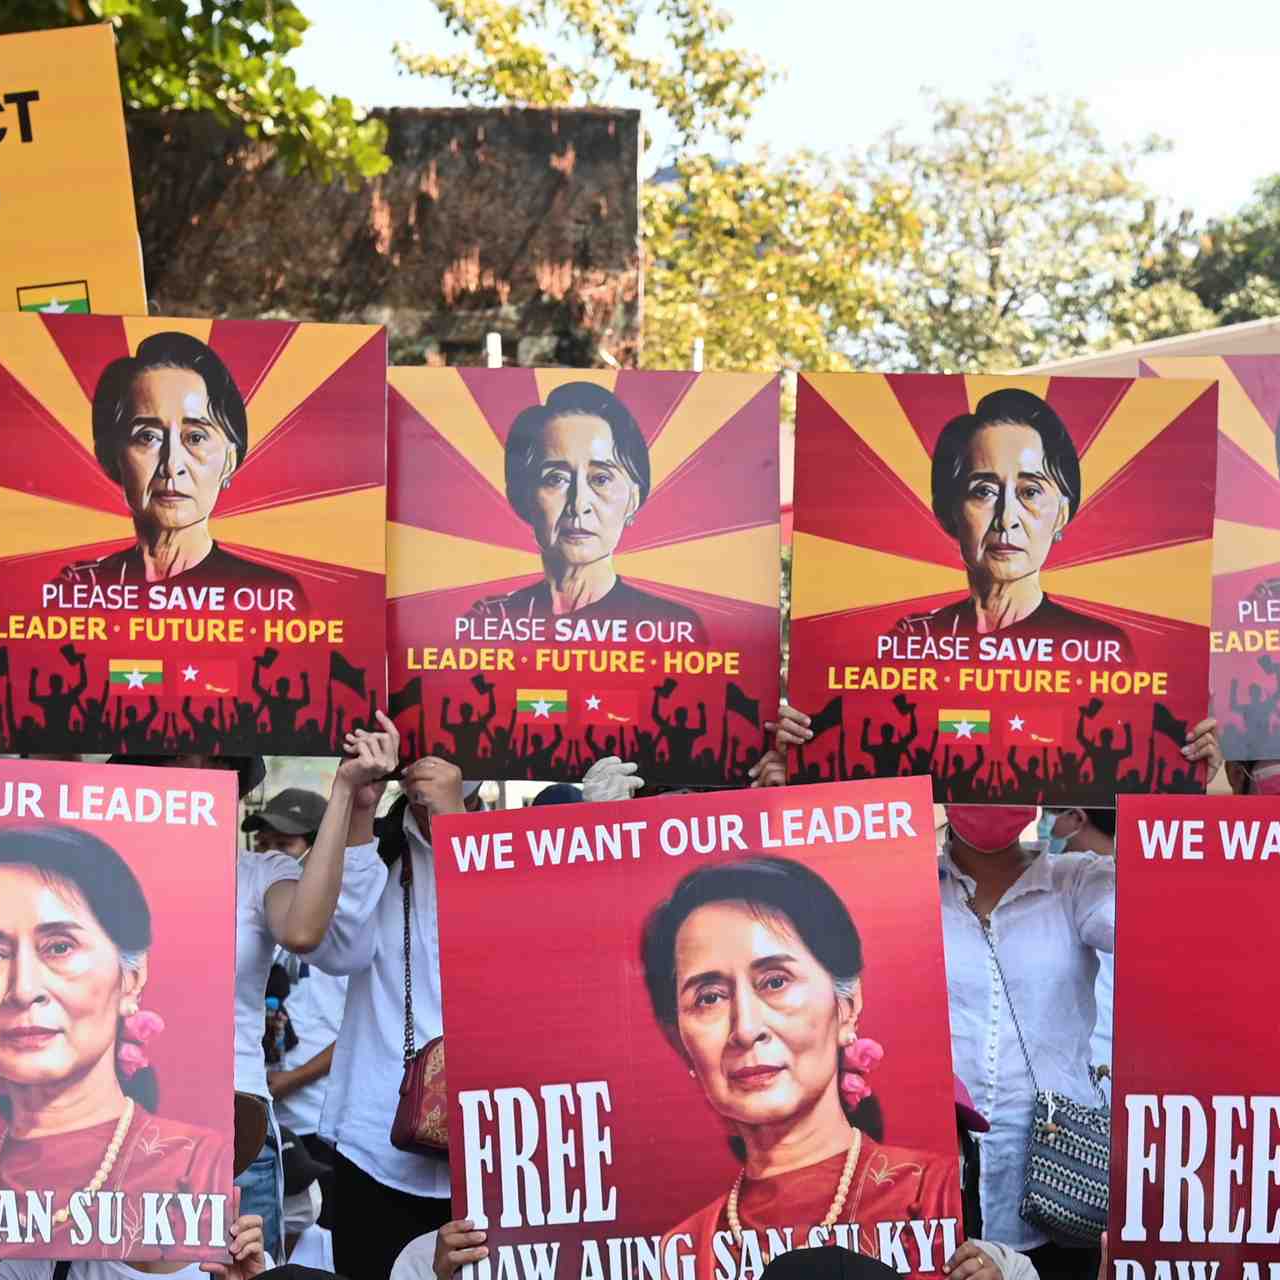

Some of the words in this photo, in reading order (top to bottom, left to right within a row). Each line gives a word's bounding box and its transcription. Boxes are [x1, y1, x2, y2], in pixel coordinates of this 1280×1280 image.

[42, 584, 138, 610] PLEASE
[148, 586, 225, 611] SAVE
[233, 588, 296, 612] OUR
[129, 618, 244, 642] FUTURE
[264, 619, 344, 643] HOPE
[455, 618, 546, 641] PLEASE
[554, 619, 627, 642] SAVE
[635, 620, 694, 643] OUR
[407, 648, 515, 671] LEADER
[535, 649, 645, 673] FUTURE
[663, 651, 739, 674] HOPE
[877, 636, 970, 661] PLEASE
[977, 637, 1055, 662] SAVE
[1061, 638, 1122, 663] OUR
[827, 666, 938, 692] LEADER
[958, 668, 1070, 694] FUTURE
[1089, 670, 1168, 696] HOPE
[58, 784, 217, 827] LEADER
[450, 832, 515, 874] WE
[525, 821, 648, 868] WANT
[658, 814, 748, 855] OUR
[759, 800, 918, 849] LEADER
[1137, 819, 1205, 860] WE
[458, 1080, 618, 1231] FREE
[69, 1190, 125, 1247] SU
[141, 1192, 228, 1248] KYI
[874, 1217, 959, 1274] KYI
